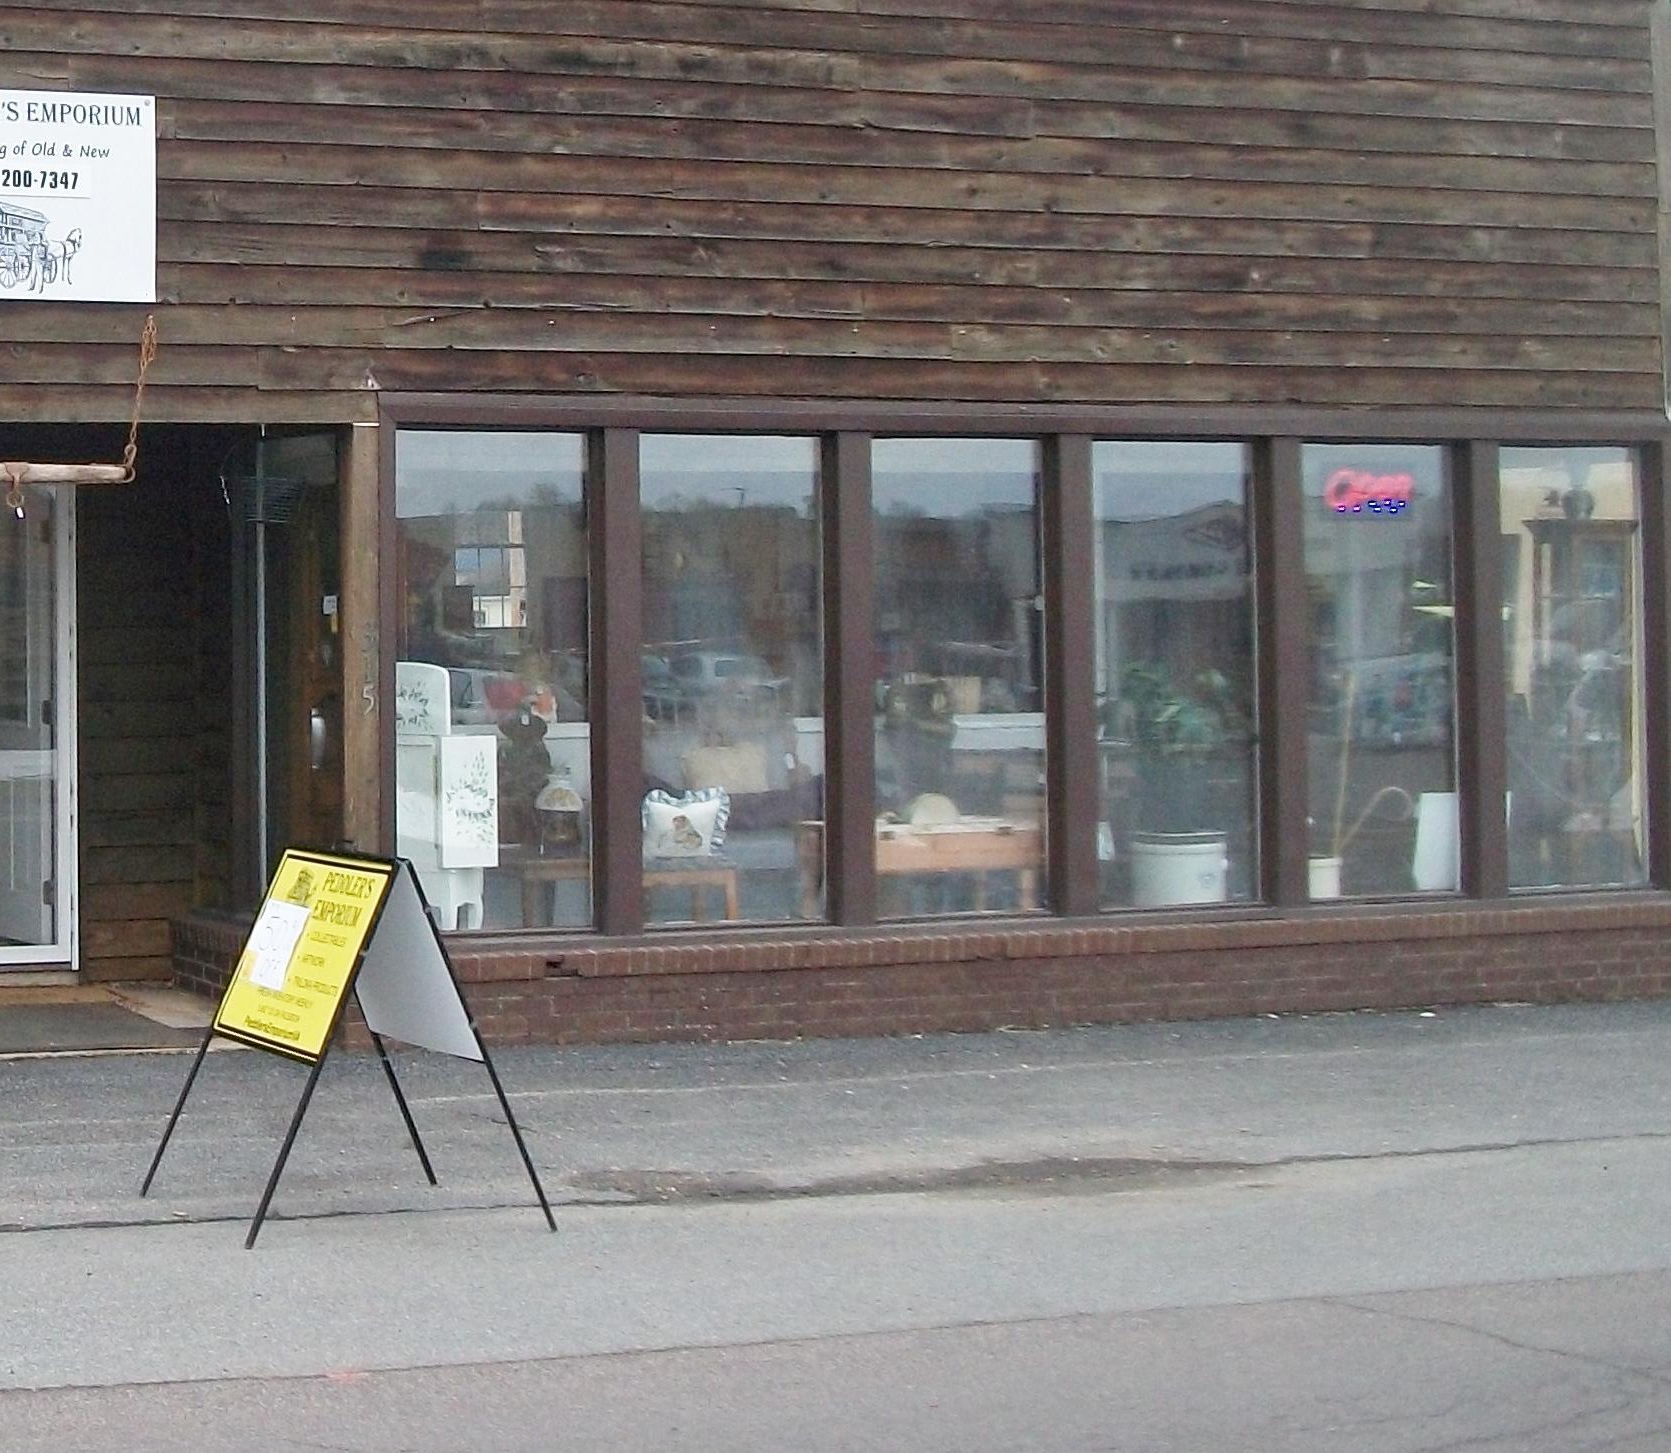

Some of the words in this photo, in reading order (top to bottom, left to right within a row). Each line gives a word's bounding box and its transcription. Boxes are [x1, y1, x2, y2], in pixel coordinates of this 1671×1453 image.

[26, 102, 142, 126] EMPORIUM
[12, 140, 28, 156] of
[31, 142, 56, 157] Old
[62, 143, 73, 158] &
[79, 145, 110, 159] New
[322, 871, 376, 899] PEDDLER'S
[311, 899, 363, 927] EMPORIUM
